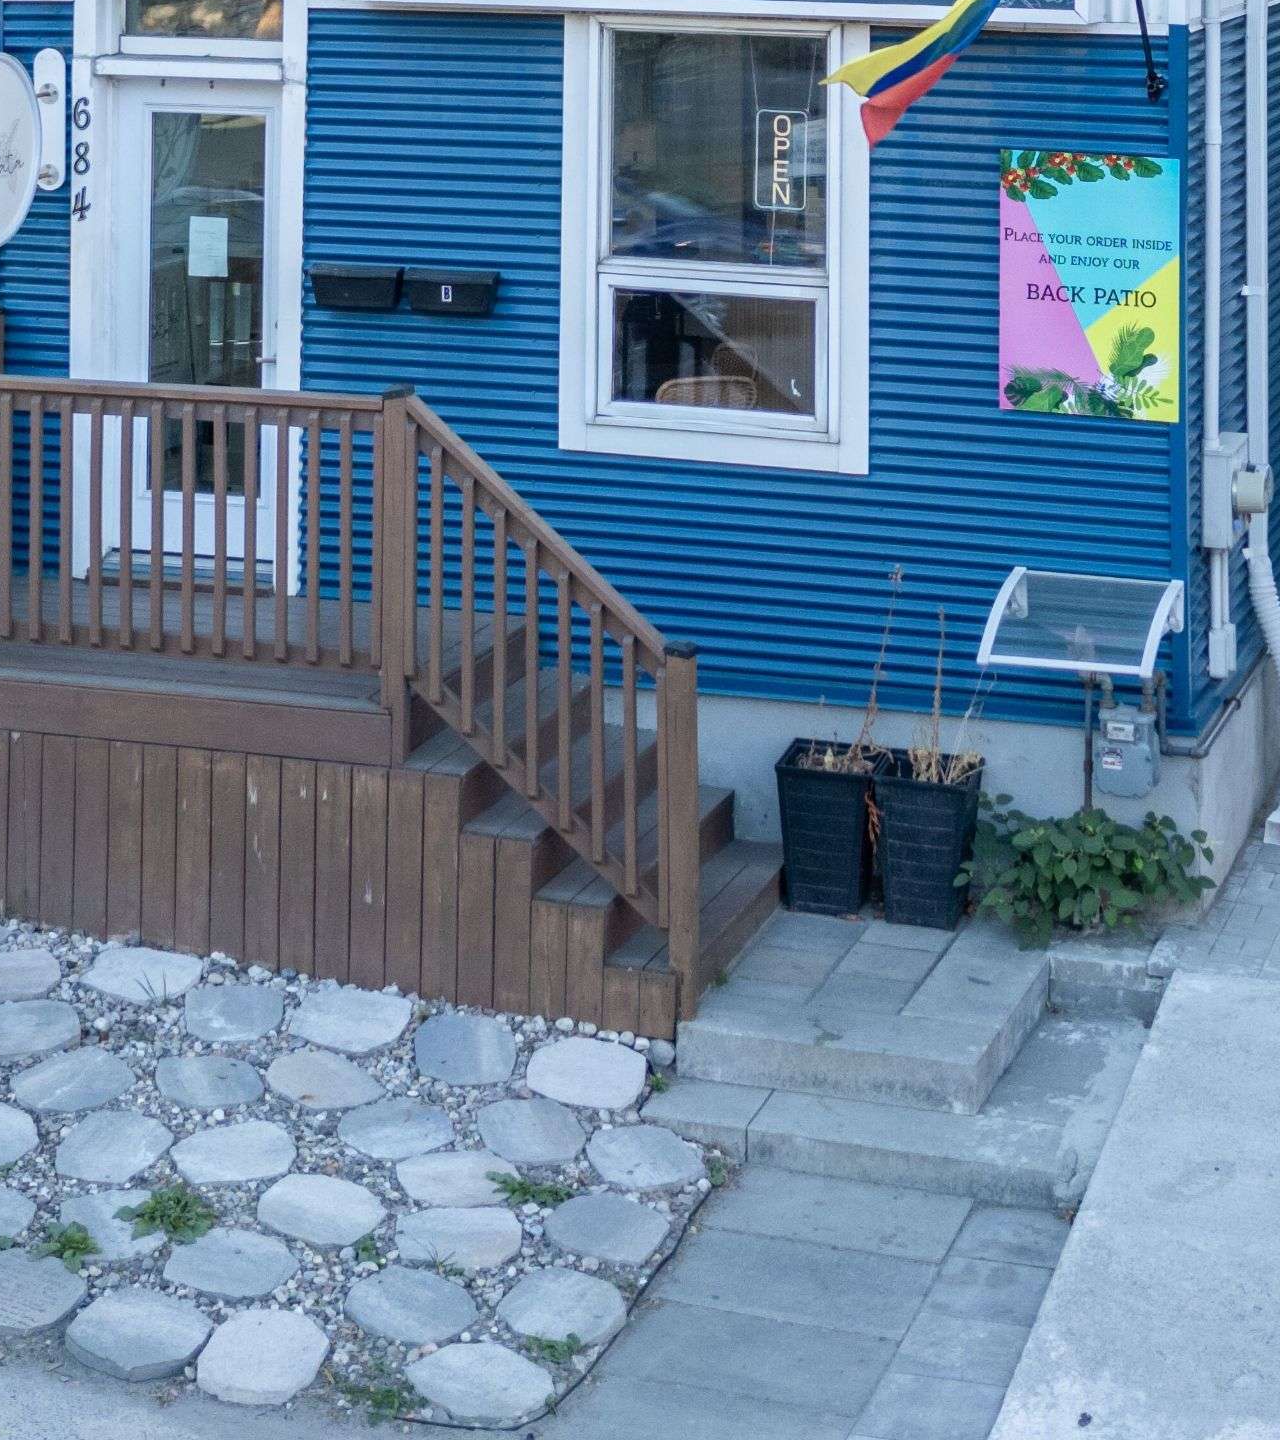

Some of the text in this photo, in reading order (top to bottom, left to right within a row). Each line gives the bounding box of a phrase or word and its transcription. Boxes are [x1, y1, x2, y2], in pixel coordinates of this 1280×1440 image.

[71, 96, 92, 222] 684
[772, 113, 791, 206] OPEN
[1047, 233, 1082, 246] YOUR
[1086, 236, 1129, 248] ORDER
[1132, 238, 1173, 252] INSIDE
[1038, 253, 1140, 270] AND ENJOY OUR
[1027, 283, 1157, 308] BACK PATIO
